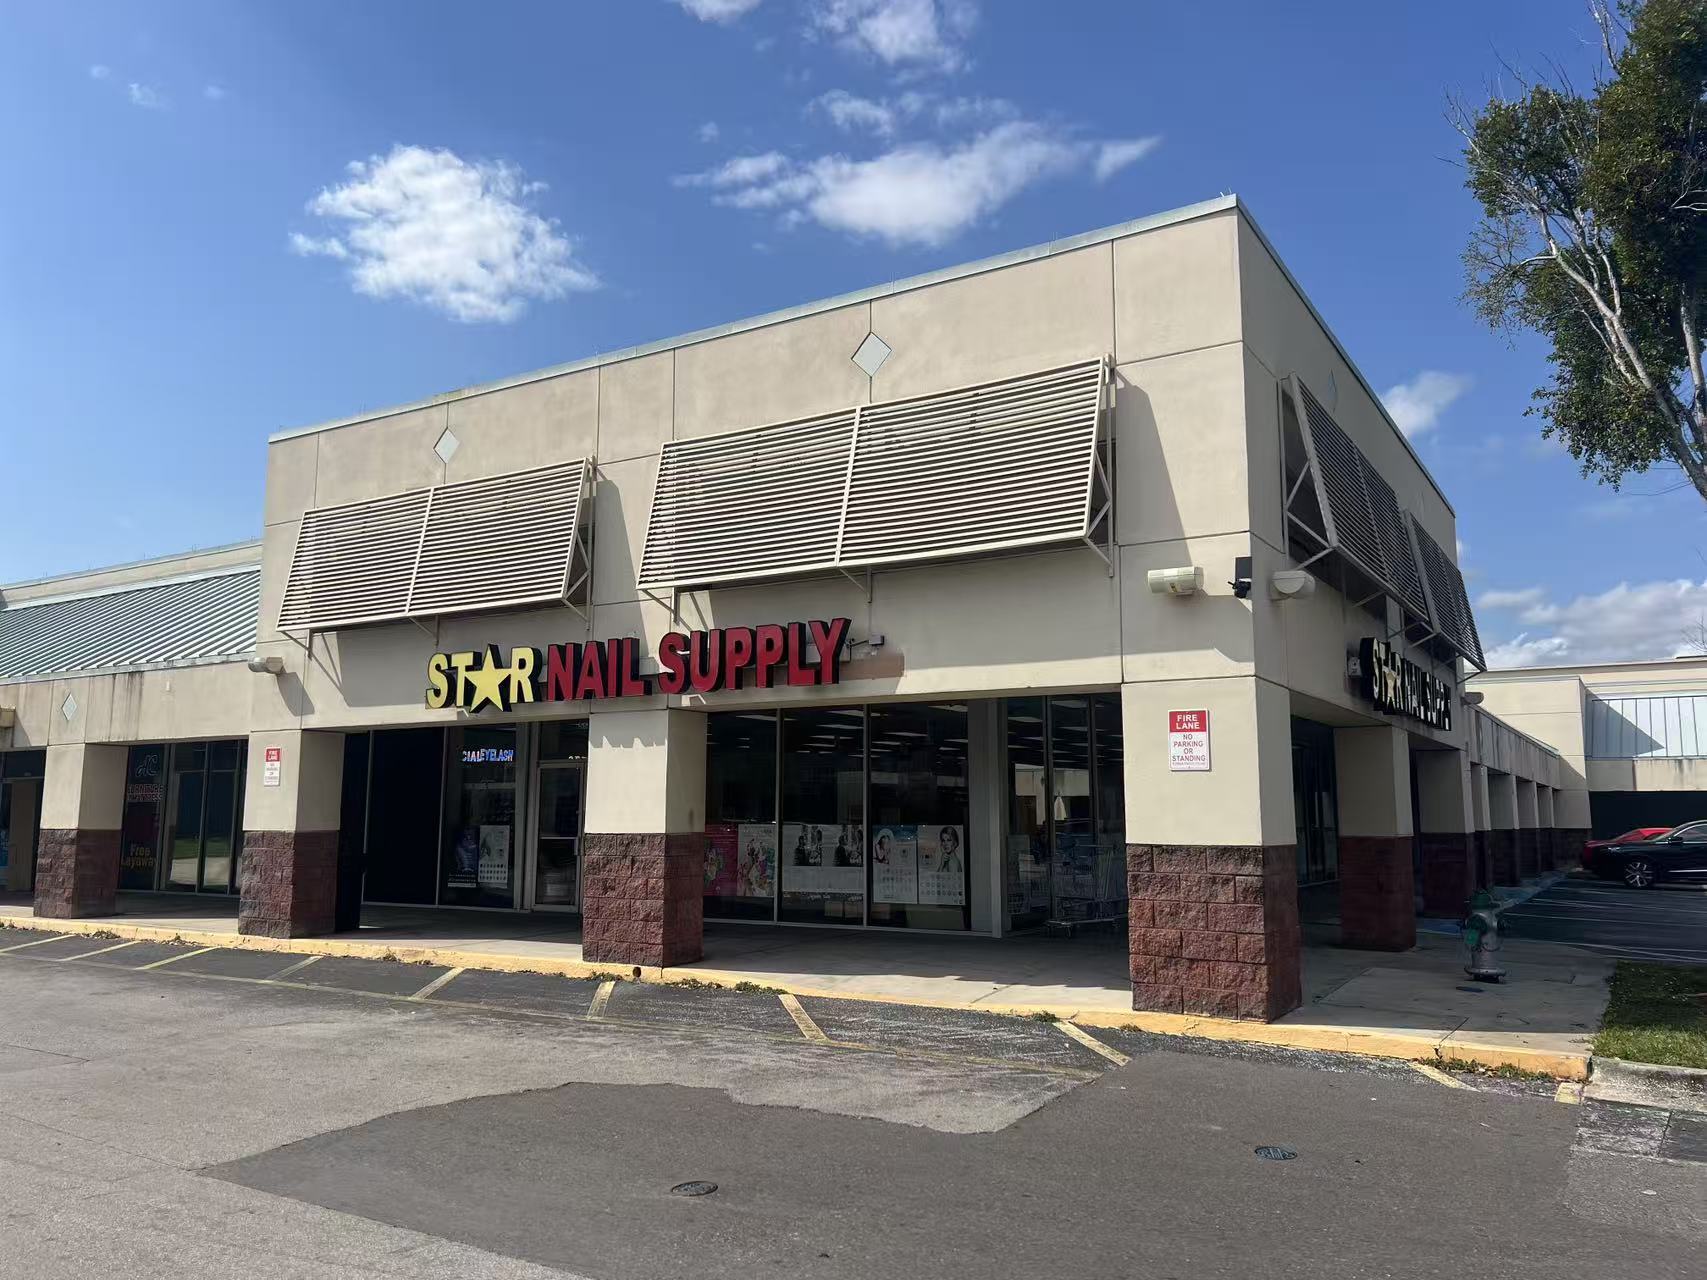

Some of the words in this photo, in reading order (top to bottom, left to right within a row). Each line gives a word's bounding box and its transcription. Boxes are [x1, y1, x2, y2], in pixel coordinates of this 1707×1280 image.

[547, 638, 651, 701] NAIL
[659, 617, 851, 695] SUPPLY
[1177, 714, 1198, 722] FIRE
[1176, 722, 1200, 730] LANE
[1173, 740, 1204, 748] PARKING
[1183, 747, 1194, 755] OR
